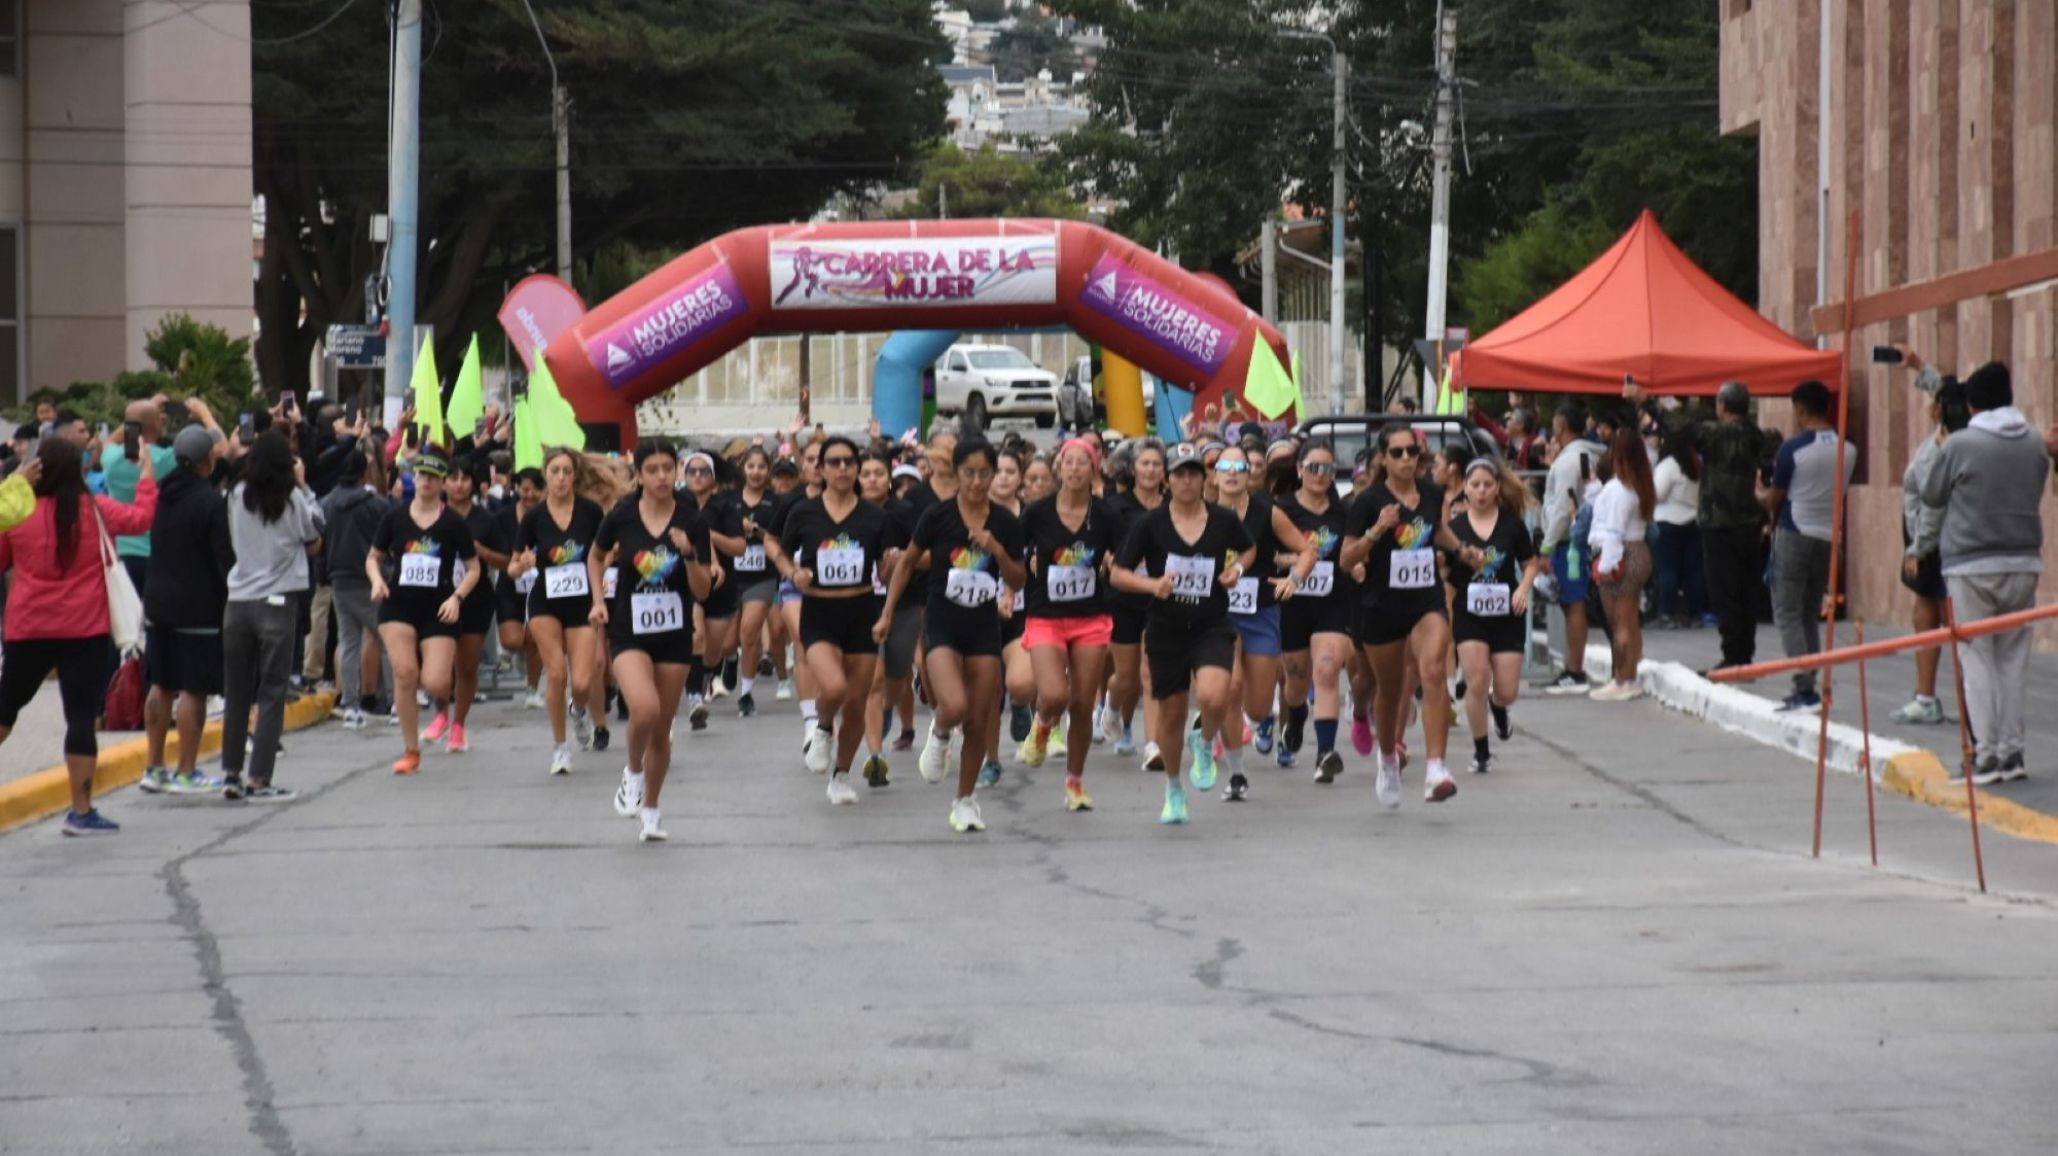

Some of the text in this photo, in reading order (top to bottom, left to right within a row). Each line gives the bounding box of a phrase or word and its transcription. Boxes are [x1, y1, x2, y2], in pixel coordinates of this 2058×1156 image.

[823, 249, 1036, 275] CARRERA DE LA
[884, 275, 974, 299] MUJER
[633, 279, 722, 343] MUJERES
[1130, 286, 1222, 348] MUJERES
[641, 294, 733, 357] SOLIDARIAS
[1123, 301, 1216, 363] SOLIDARIAS
[406, 566, 436, 583] 085
[824, 564, 858, 581] 061
[1398, 564, 1431, 584] 015
[552, 576, 583, 594] 229
[952, 585, 989, 603] 218
[1055, 578, 1090, 598] 017
[1474, 596, 1506, 613] 062
[640, 607, 677, 628] 001
